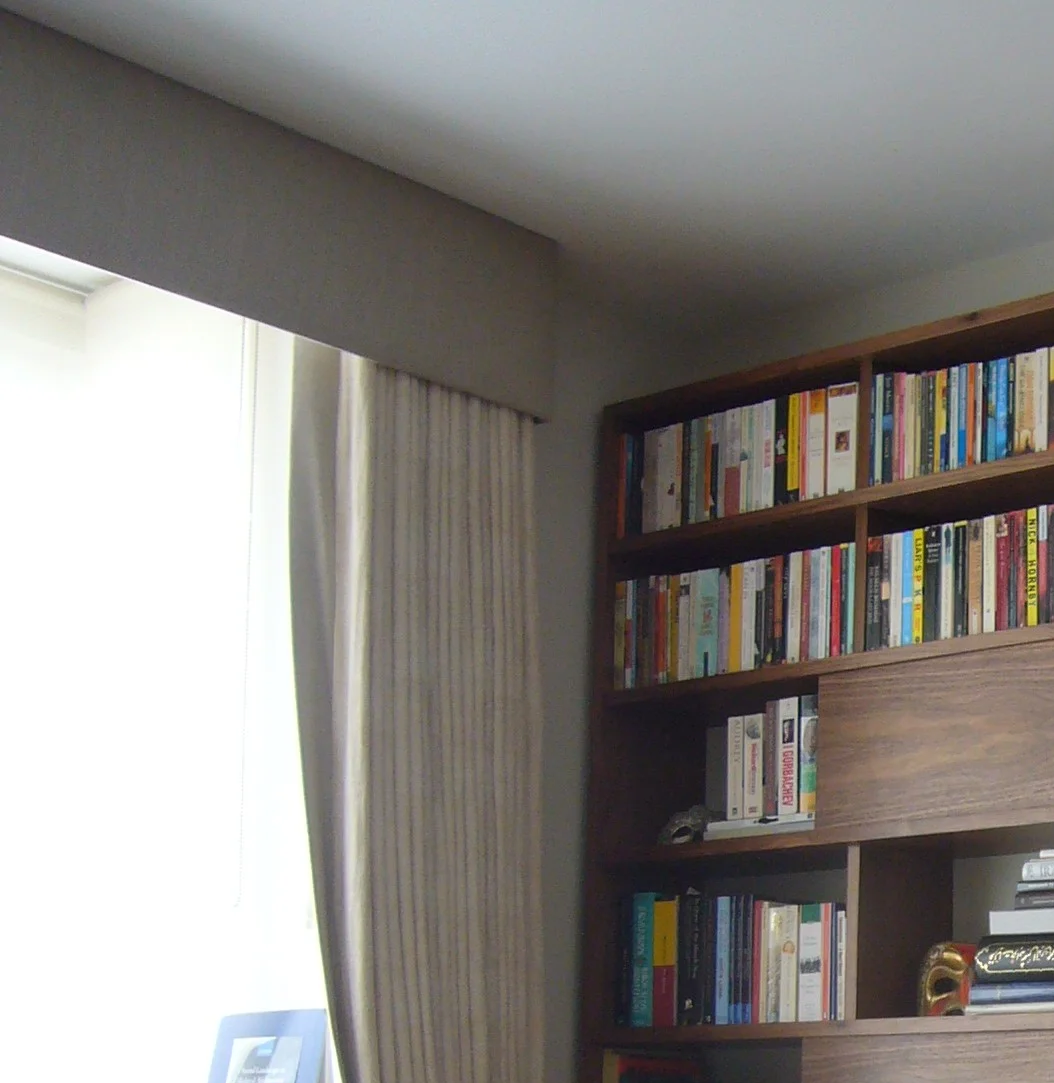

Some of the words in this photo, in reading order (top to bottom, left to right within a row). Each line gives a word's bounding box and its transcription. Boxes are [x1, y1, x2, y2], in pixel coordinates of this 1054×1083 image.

[1028, 518, 1037, 545] NICK
[914, 537, 923, 572] LIAR'S
[1027, 559, 1037, 607] HORNBY
[782, 750, 794, 806] GORBACHEV
